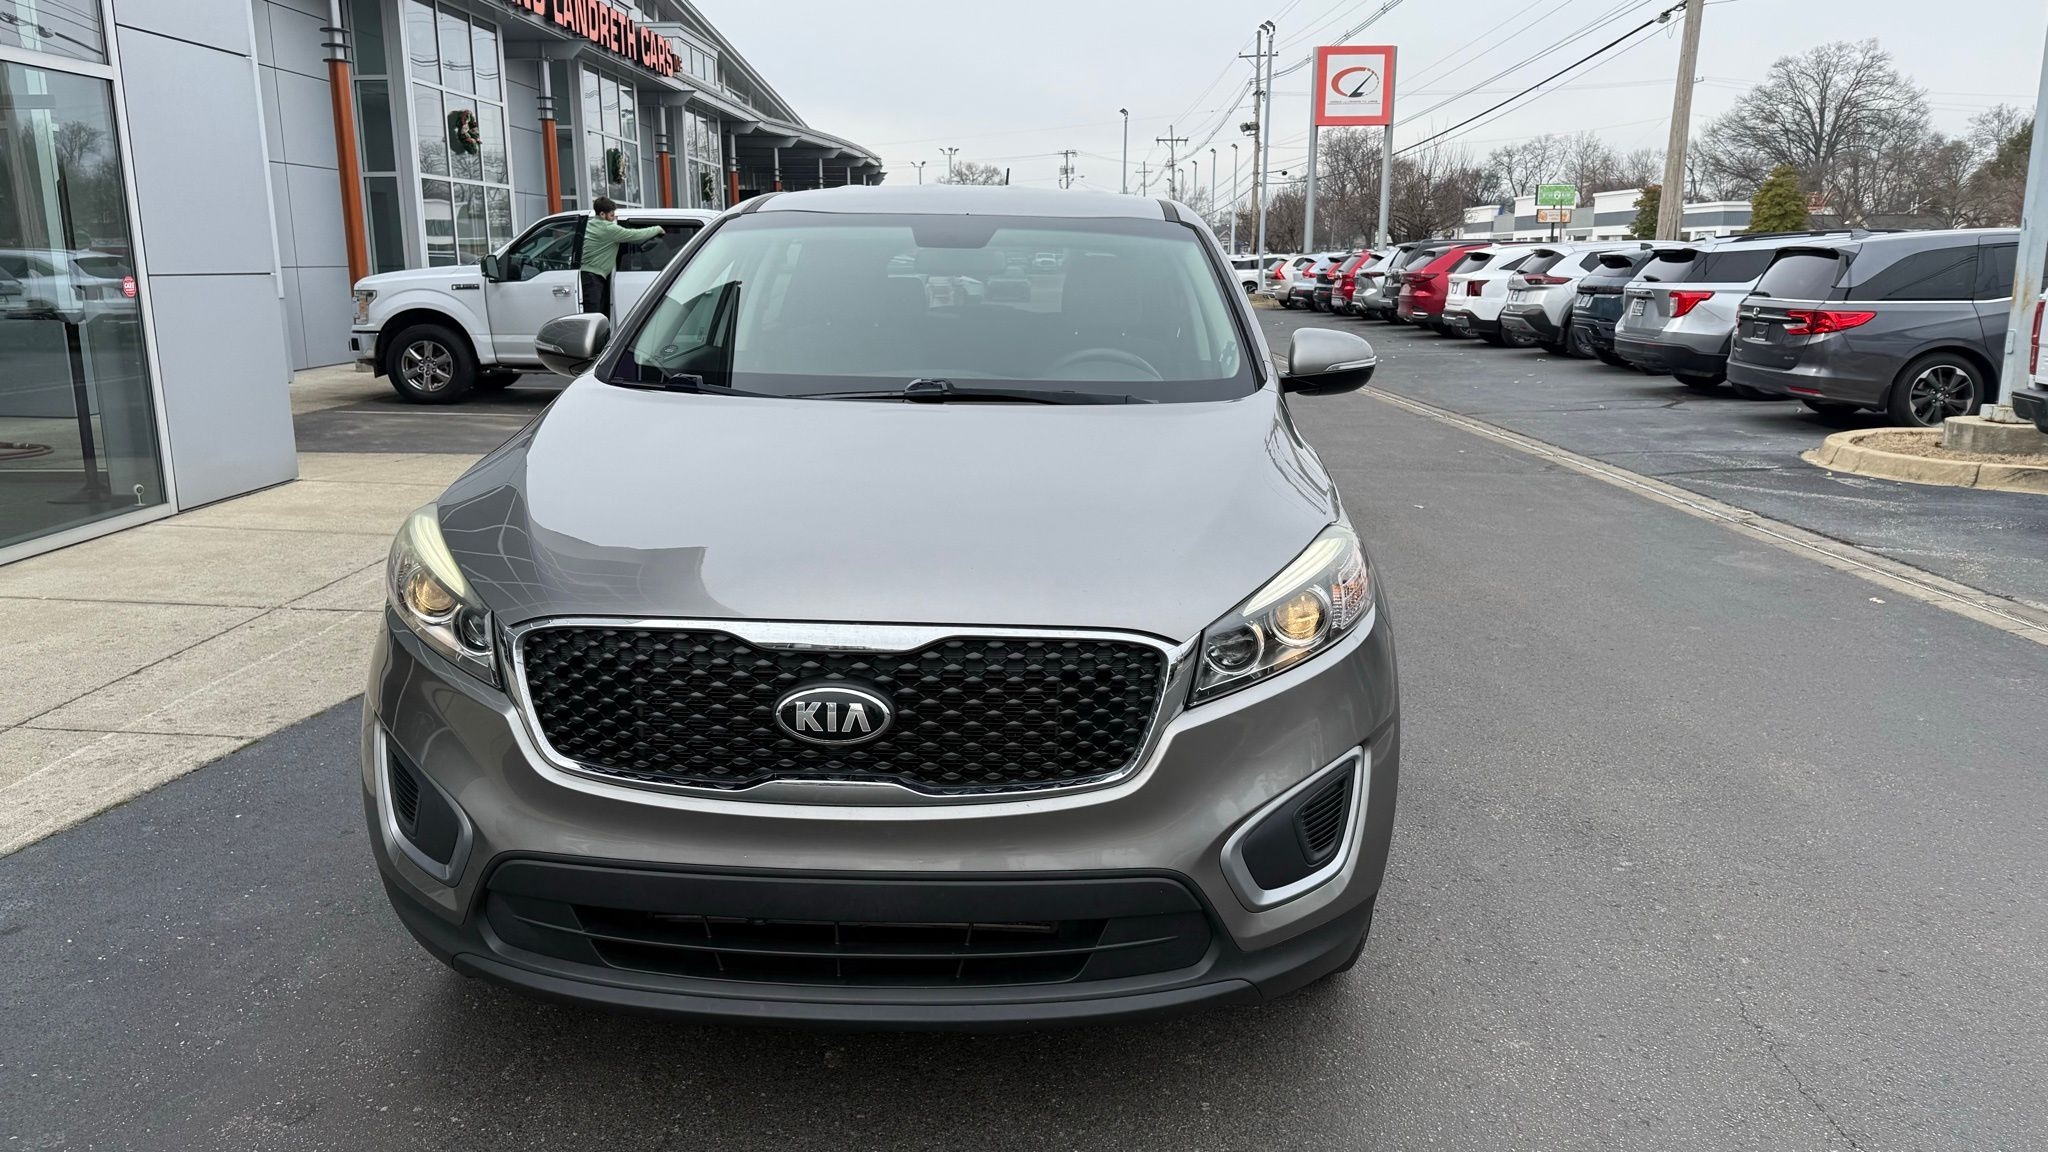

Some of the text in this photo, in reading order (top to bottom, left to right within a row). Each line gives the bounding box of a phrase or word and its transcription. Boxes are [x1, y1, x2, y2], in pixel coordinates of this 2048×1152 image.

[552, 0, 674, 77] LANDRETH CARS
[795, 701, 871, 732] KIA
